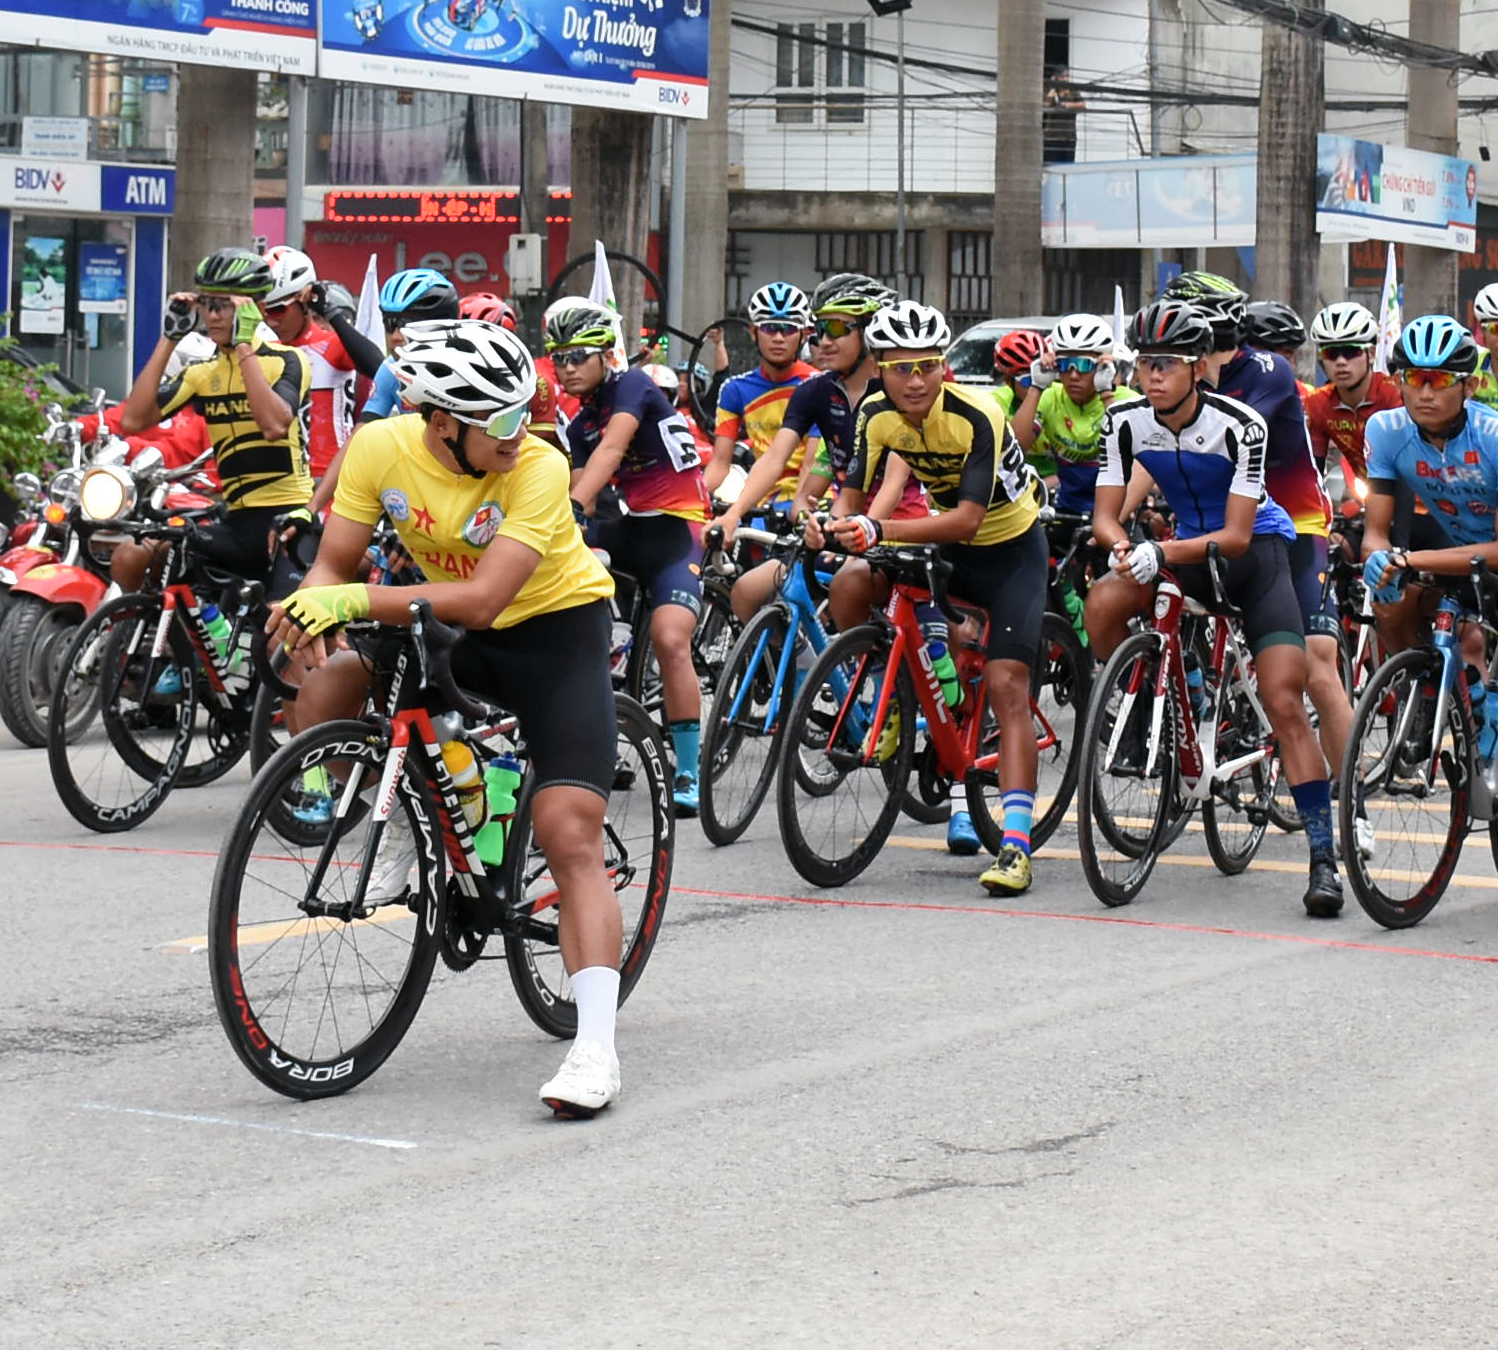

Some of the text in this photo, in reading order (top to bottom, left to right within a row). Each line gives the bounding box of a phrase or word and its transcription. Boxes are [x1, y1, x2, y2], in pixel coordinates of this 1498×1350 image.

[562, 6, 657, 57] Dự Thưởng
[659, 86, 681, 104] BIDV
[15, 167, 50, 190] BIDV
[125, 175, 167, 206] ATM
[641, 736, 669, 841] BORA
[268, 1047, 356, 1083] BORA
